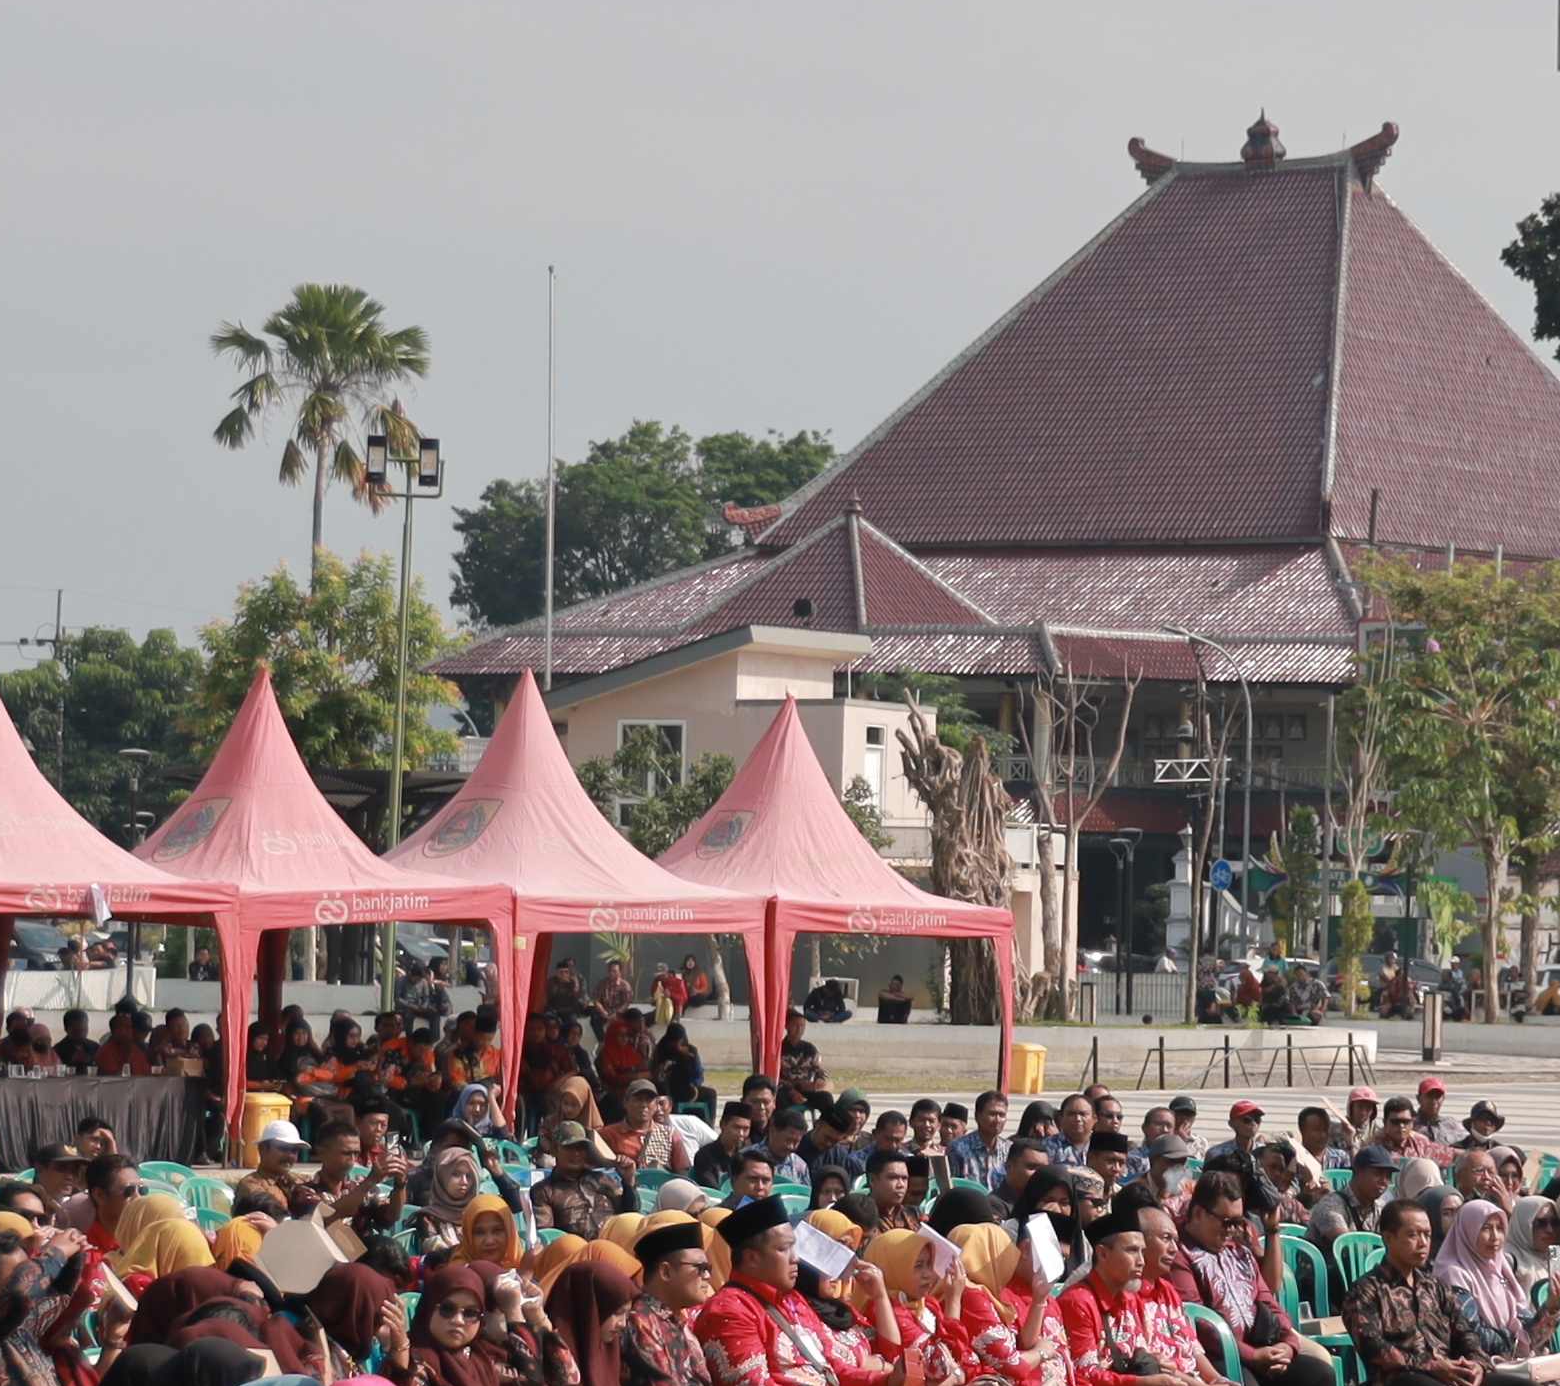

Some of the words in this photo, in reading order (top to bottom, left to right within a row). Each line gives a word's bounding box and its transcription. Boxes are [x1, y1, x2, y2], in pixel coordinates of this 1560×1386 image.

[353, 892, 429, 914] bankjatim
[353, 913, 388, 921] PEDULI
[623, 904, 694, 924] bankjatim
[879, 909, 947, 929] bankjatim
